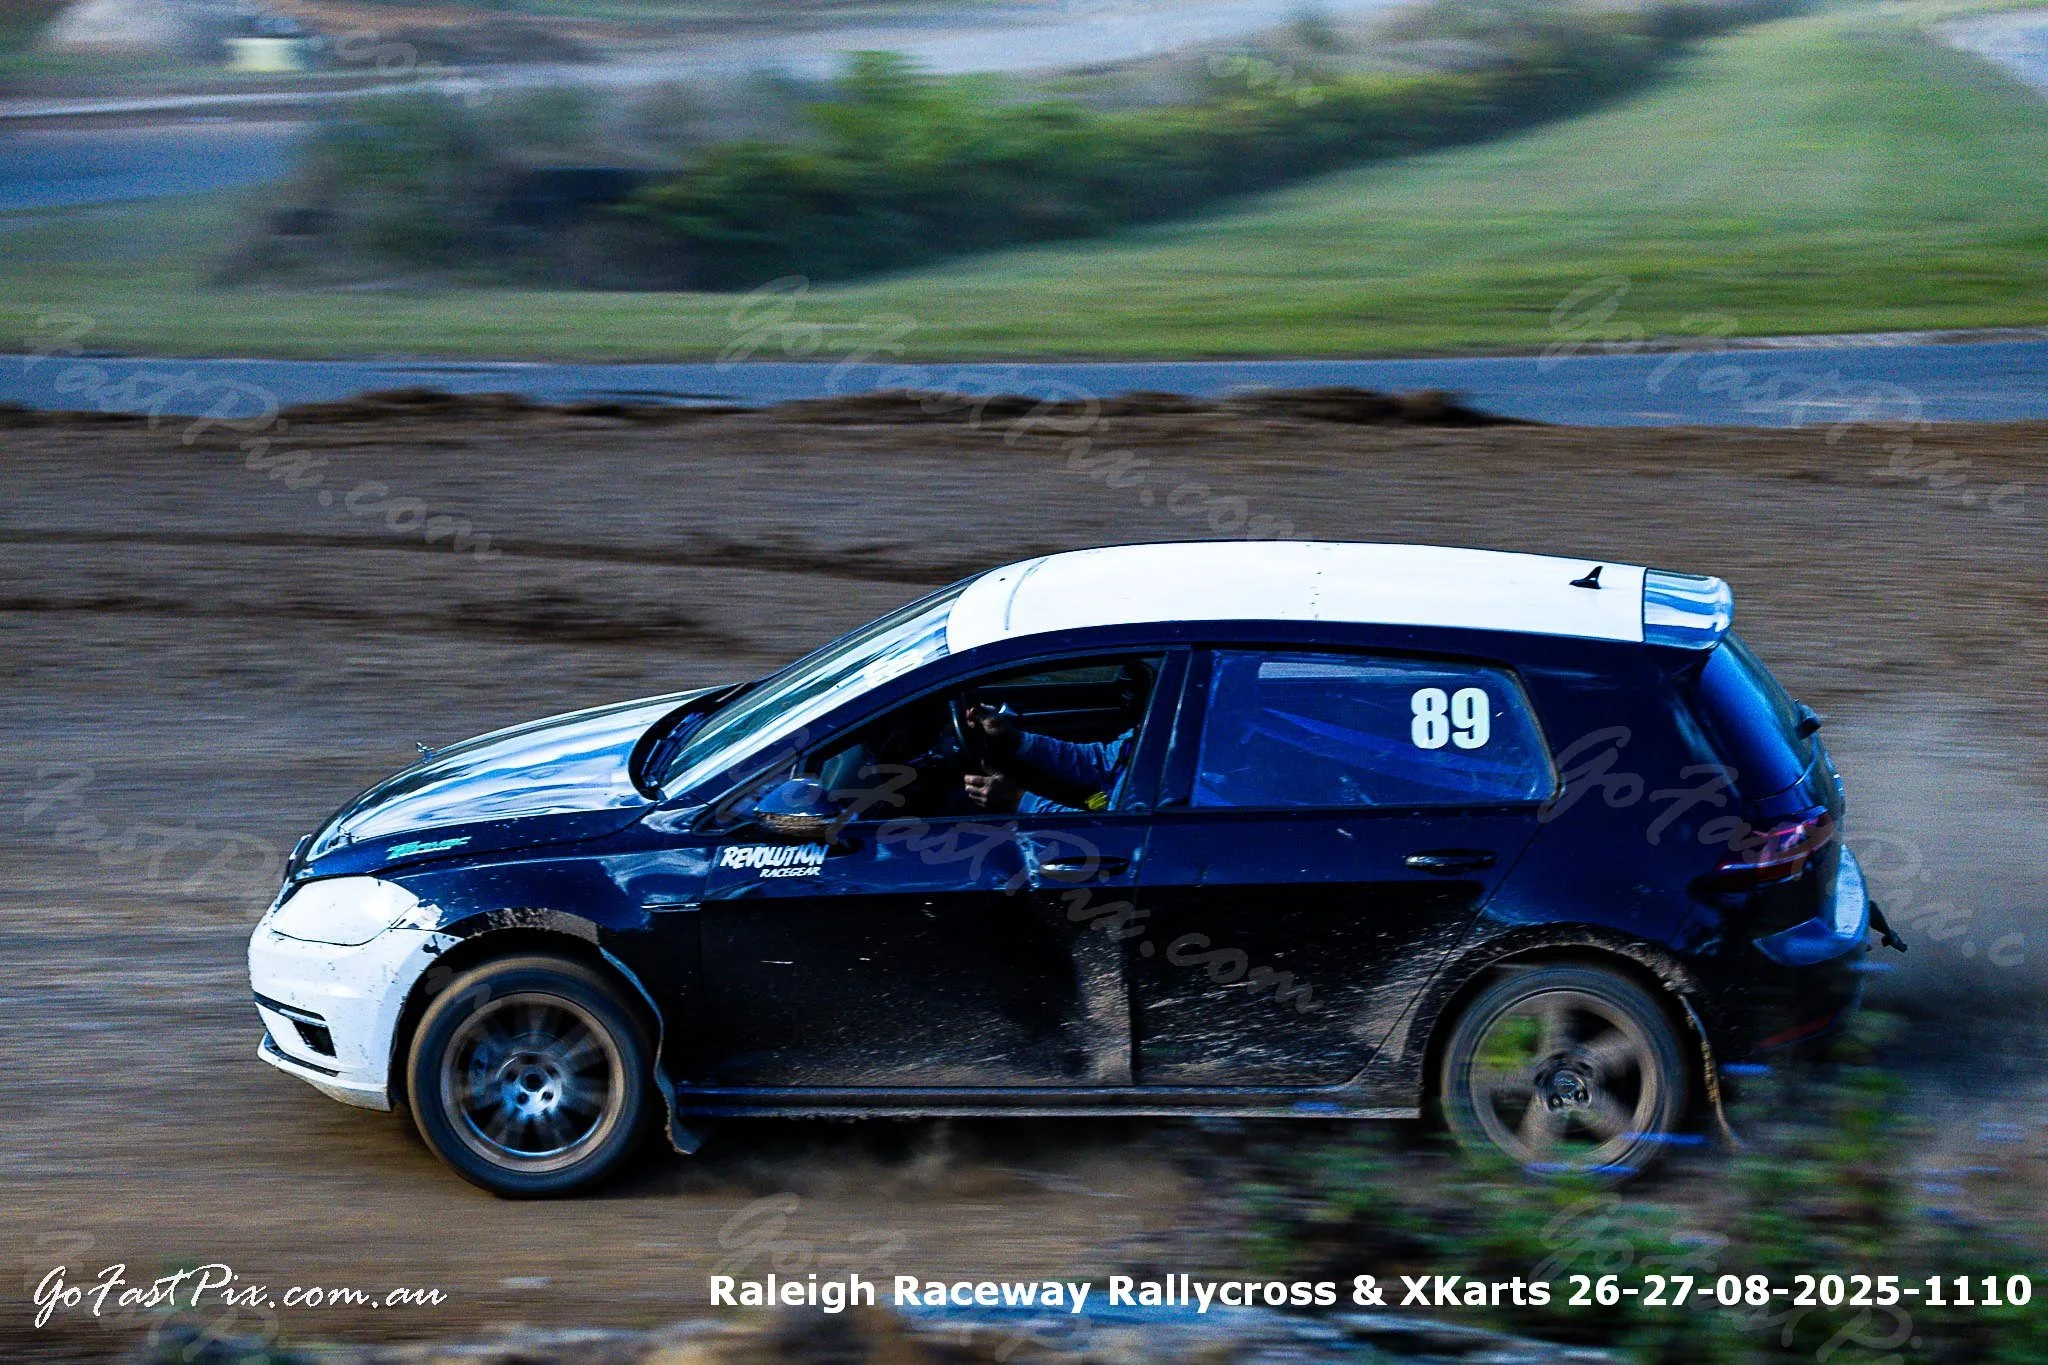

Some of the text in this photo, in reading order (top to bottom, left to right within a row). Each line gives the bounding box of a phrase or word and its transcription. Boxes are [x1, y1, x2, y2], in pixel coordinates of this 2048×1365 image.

[1411, 687, 1491, 750] 89
[720, 843, 829, 869] REVOLUTION
[759, 867, 821, 877] RACEGEAR
